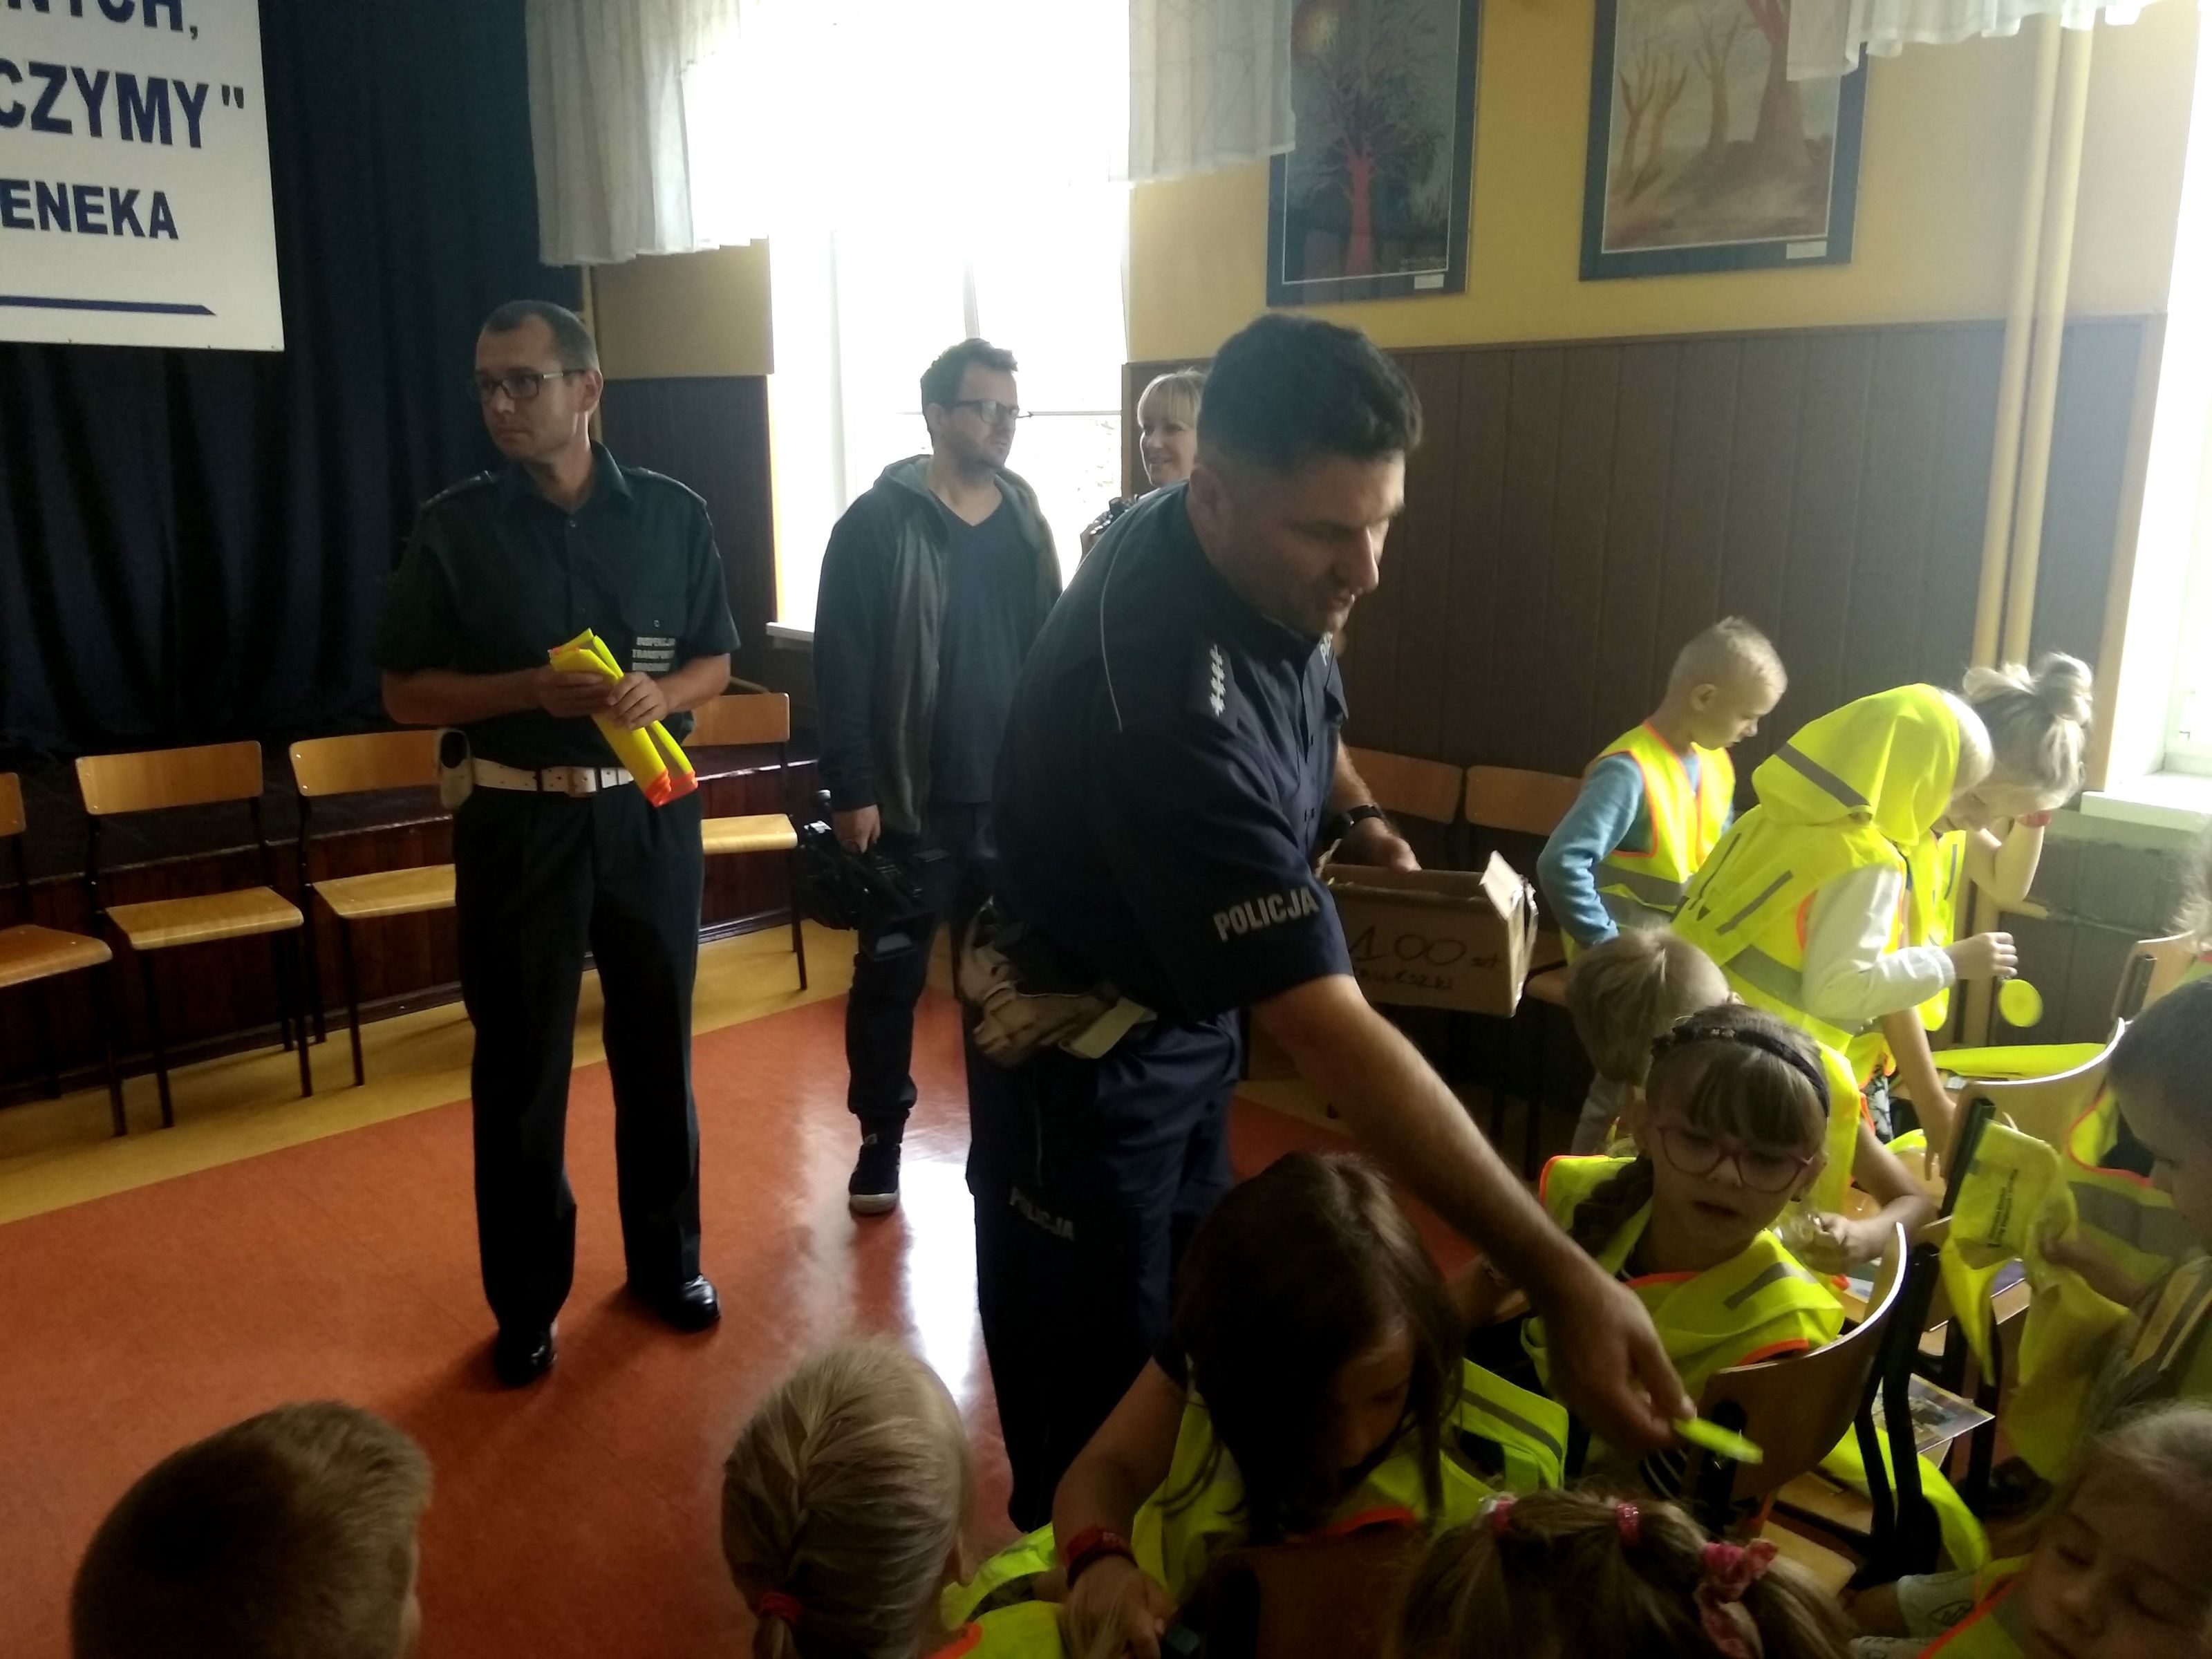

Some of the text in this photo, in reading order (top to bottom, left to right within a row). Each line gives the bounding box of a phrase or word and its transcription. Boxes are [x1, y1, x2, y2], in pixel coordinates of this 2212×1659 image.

[0, 178, 179, 241] ENEKA
[1212, 885, 1321, 944] POLICJA
[1349, 926, 1467, 965] 100
